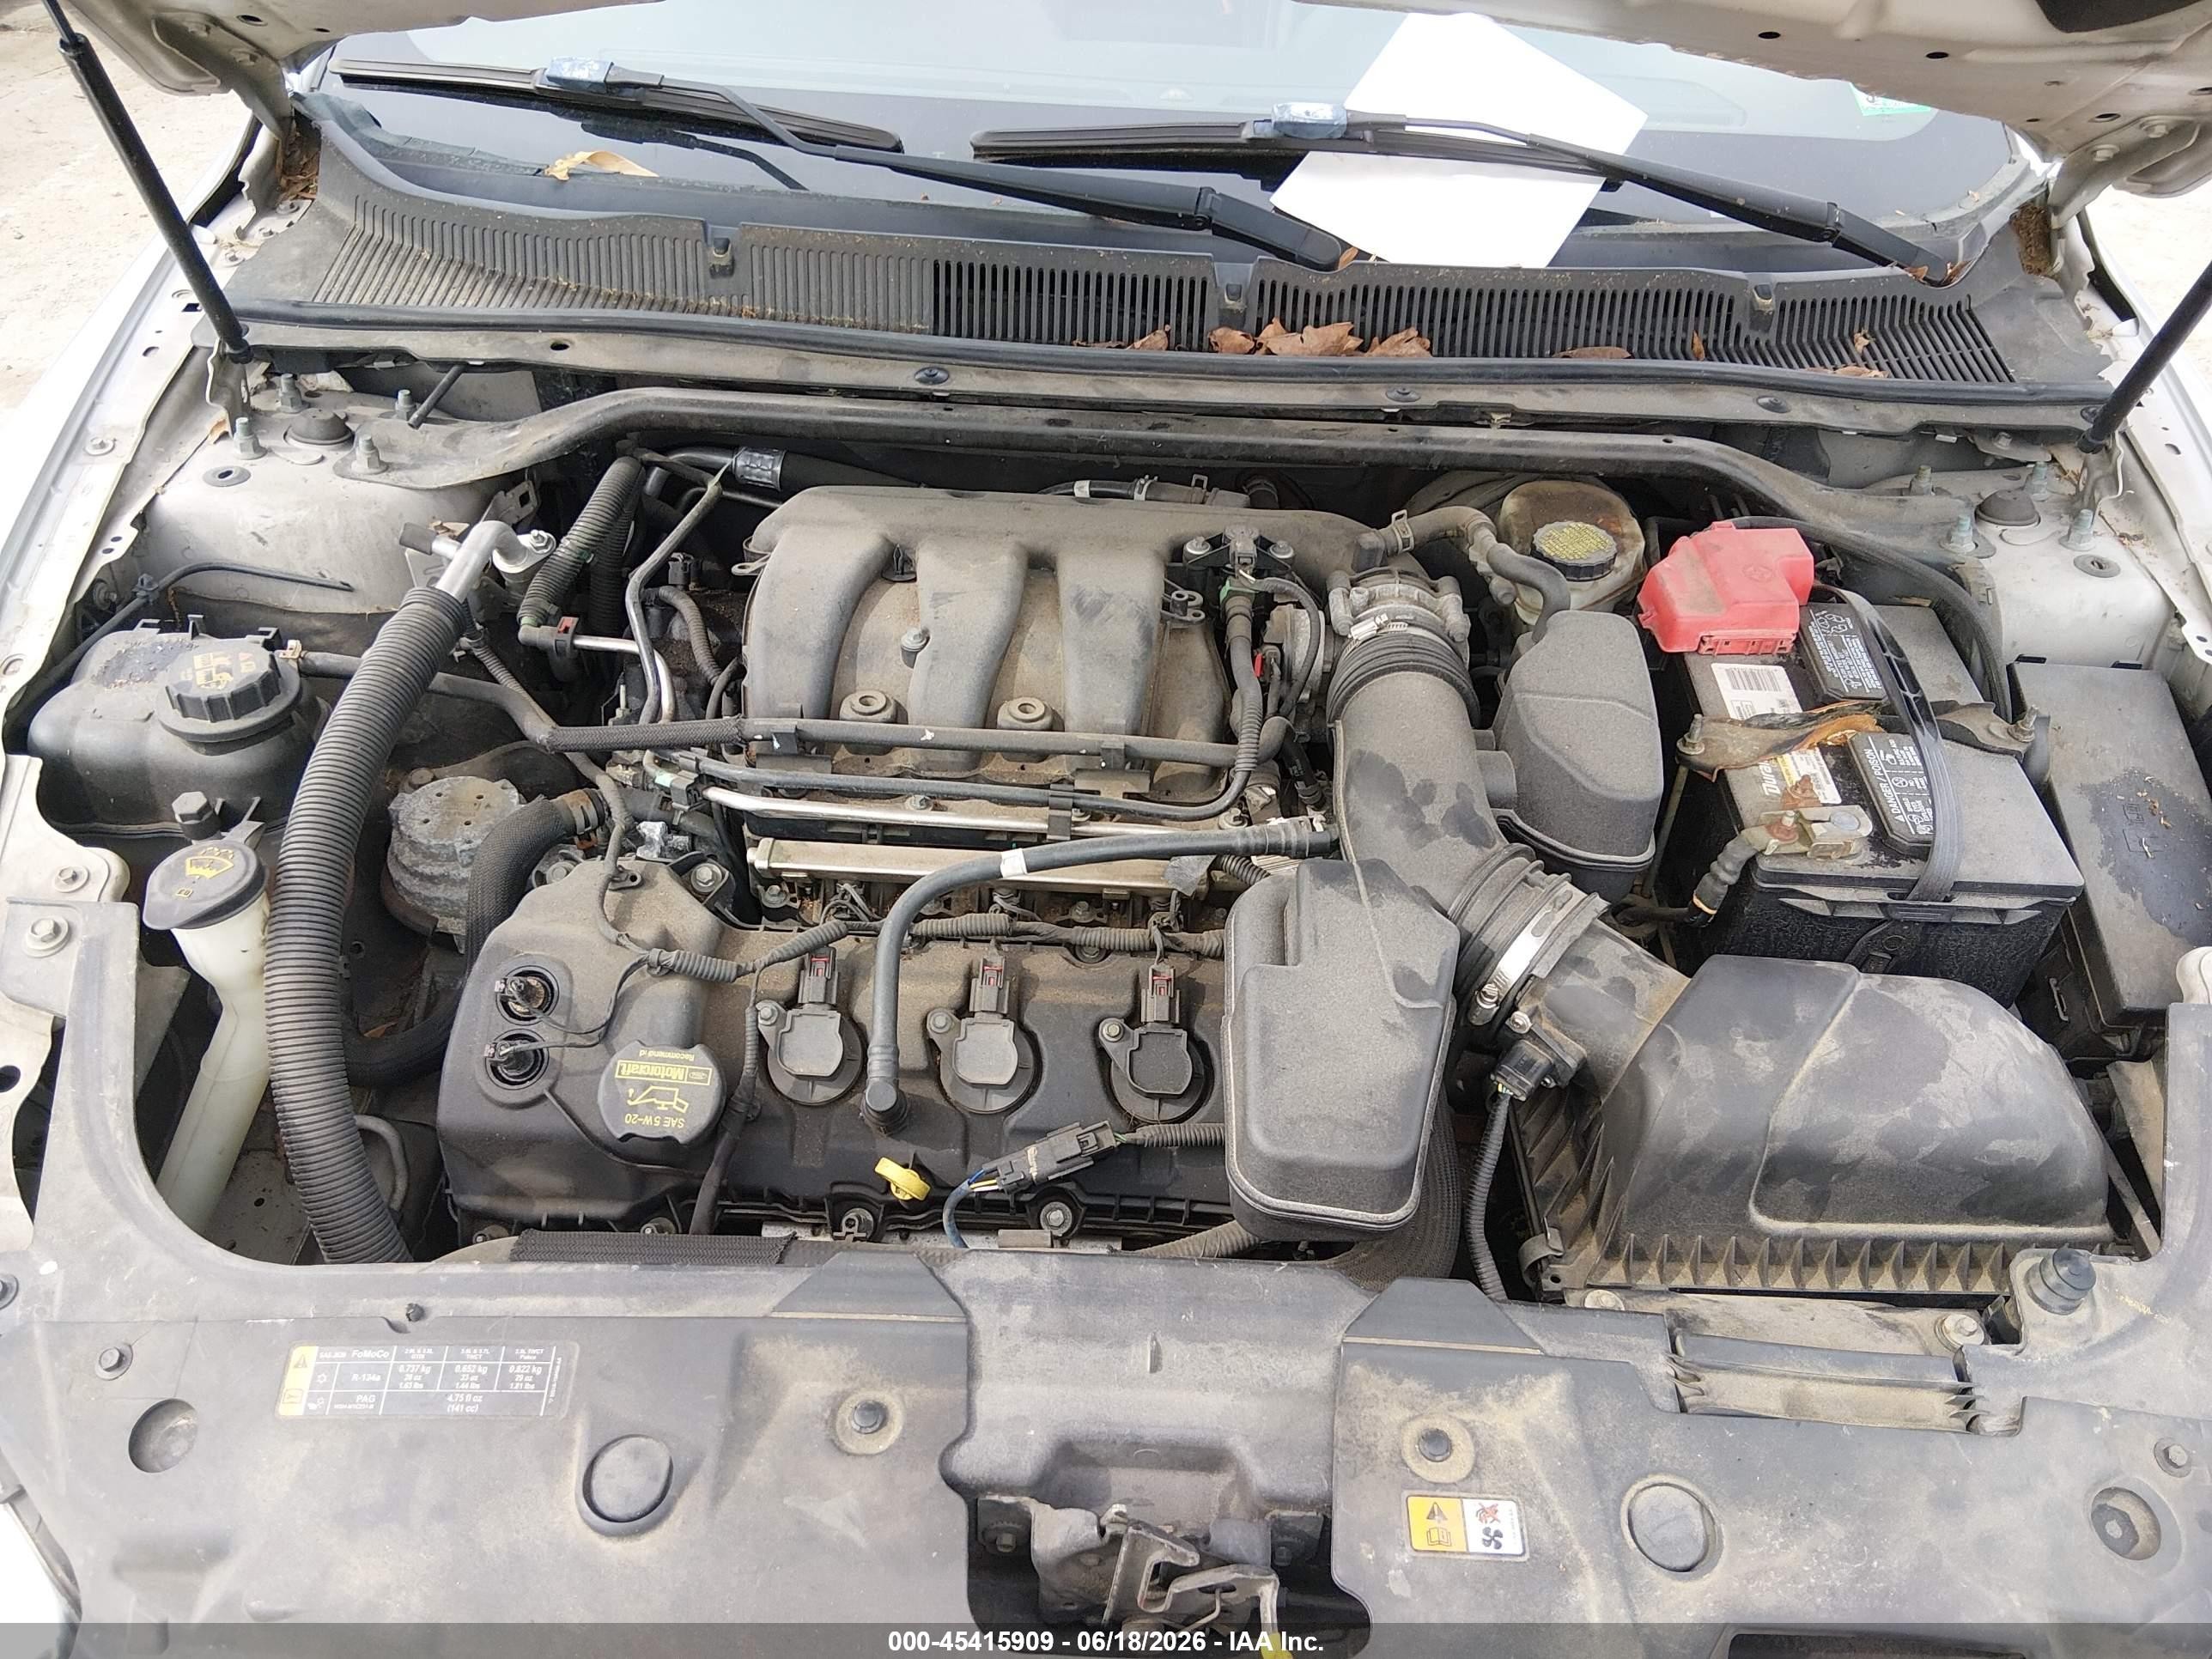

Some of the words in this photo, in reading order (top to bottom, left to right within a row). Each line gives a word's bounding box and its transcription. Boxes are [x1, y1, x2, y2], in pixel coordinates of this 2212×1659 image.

[1863, 748, 1884, 776] POISON
[1879, 782, 1902, 814] DANGER
[619, 1063, 685, 1080] Motorcraft
[624, 1113, 660, 1127] 5W-20
[662, 1116, 685, 1129] SAE
[351, 1349, 390, 1358] FoMoCo
[420, 1364, 431, 1375] kg
[477, 1364, 488, 1374] kg
[532, 1364, 543, 1375] kg
[351, 1373, 381, 1382] R-134a
[356, 1394, 376, 1402] PAG
[465, 1393, 471, 1401] fl
[447, 1403, 465, 1413] (141
[465, 1403, 479, 1413] cc)
